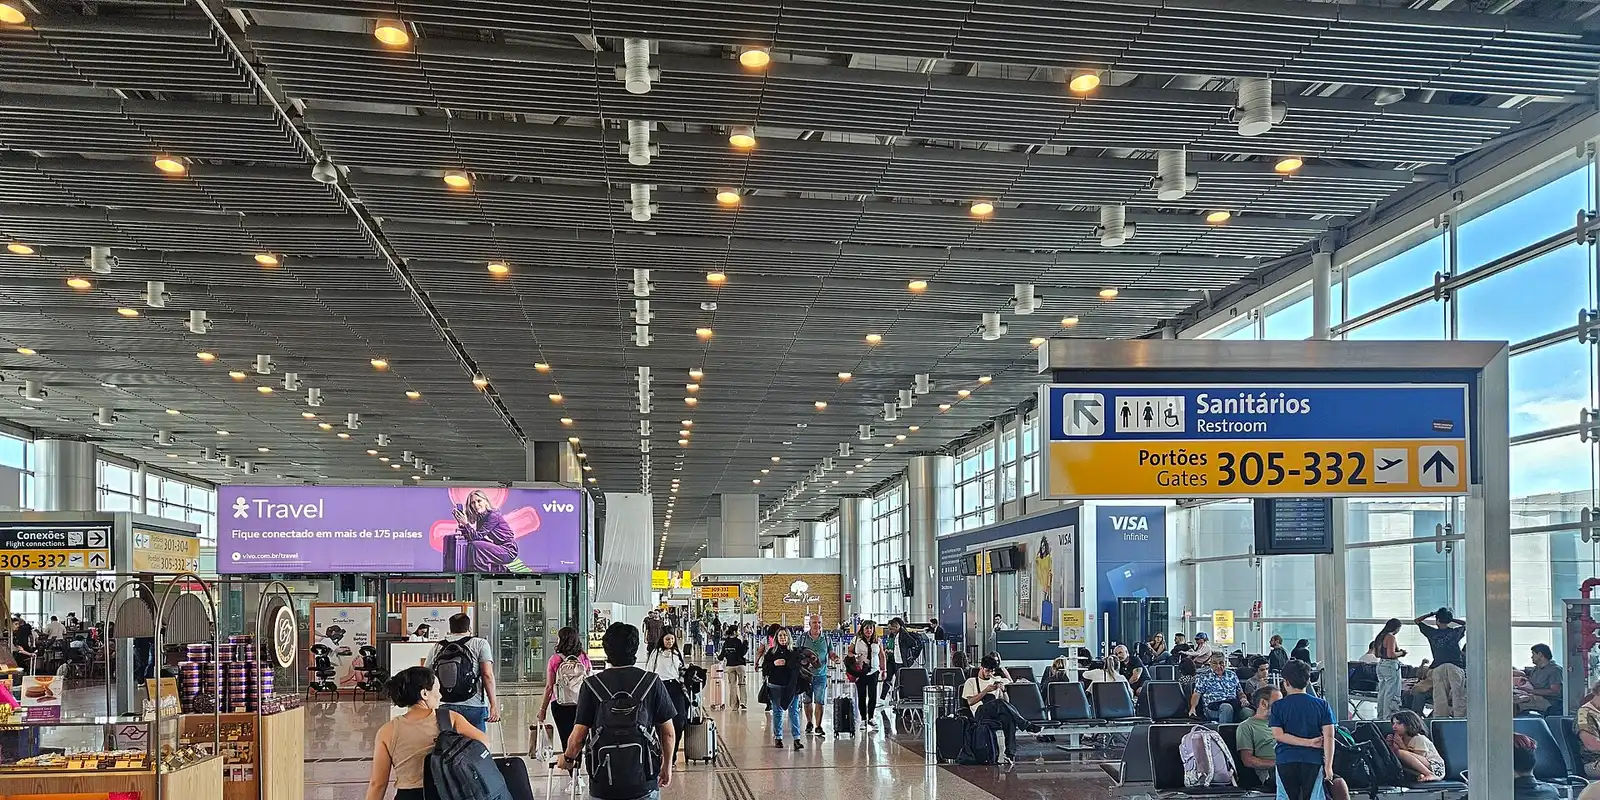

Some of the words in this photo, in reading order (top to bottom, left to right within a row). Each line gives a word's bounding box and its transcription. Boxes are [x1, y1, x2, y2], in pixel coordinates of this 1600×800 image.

[1196, 392, 1311, 414] Sanitários
[1197, 419, 1267, 432] Restroom
[1139, 449, 1208, 466] Portões
[1217, 451, 1367, 486] 305-332
[1157, 470, 1208, 487] Gates
[252, 498, 324, 519] Travel
[542, 500, 575, 513] vivo
[1109, 516, 1149, 530] VISA
[17, 531, 65, 540] Conexões
[232, 530, 260, 540] Fique
[262, 530, 314, 538] conectado
[334, 530, 357, 538] mais
[359, 530, 372, 538] de
[374, 530, 390, 538] 175
[393, 530, 423, 540] países
[1058, 533, 1072, 545] VISA
[1123, 532, 1149, 541] Infinite
[6, 540, 25, 549] Flight
[164, 538, 188, 552] 301-304
[1, 554, 67, 568] 305-332
[242, 552, 299, 560] vivo.com.br/travel
[161, 557, 185, 570] 305-332
[34, 576, 101, 592] STARBUCKS
